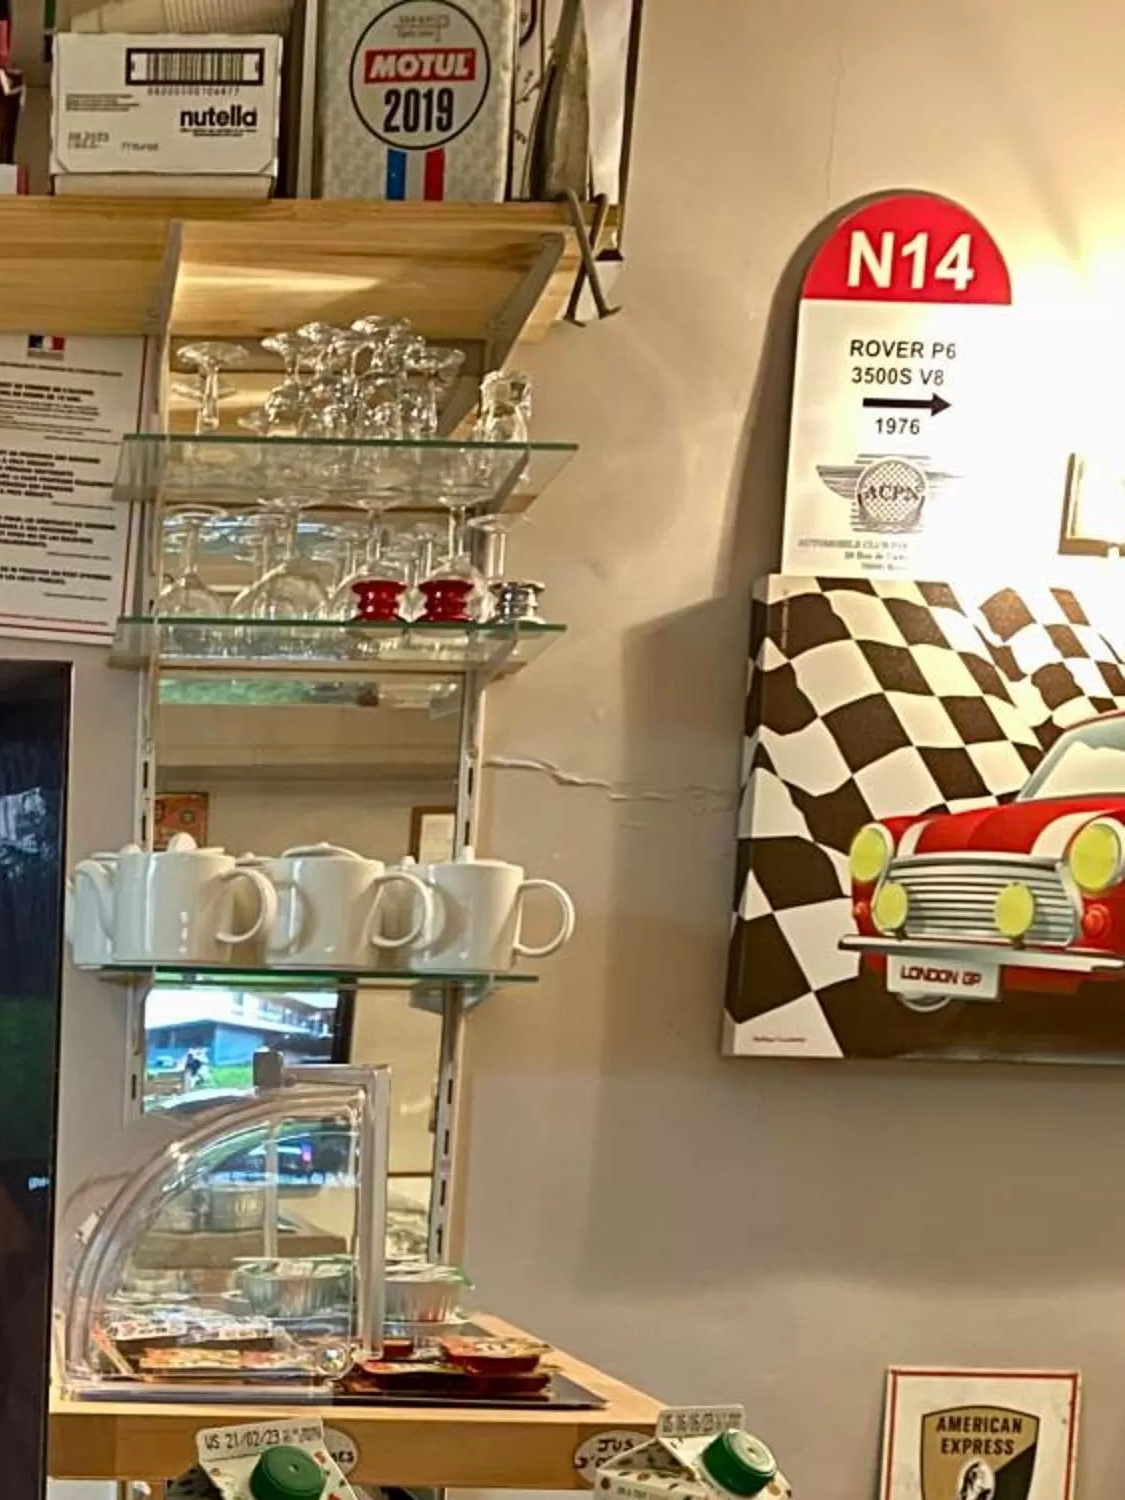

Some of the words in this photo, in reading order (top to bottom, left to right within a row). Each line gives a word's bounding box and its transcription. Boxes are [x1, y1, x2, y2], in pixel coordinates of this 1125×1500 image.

[369, 52, 470, 79] MOTUL
[180, 104, 258, 127] nutella
[383, 87, 455, 133] 2019
[846, 230, 975, 291] N14
[849, 339, 925, 359] ROVER
[931, 342, 957, 360] P6
[851, 366, 913, 386] 3500S
[920, 368, 945, 387] V8
[874, 417, 921, 436] 1976
[900, 965, 958, 985] LONDON
[961, 970, 982, 987] GP
[936, 1416, 1023, 1434] AMERICAN
[940, 1438, 1015, 1456] EXPRESS
